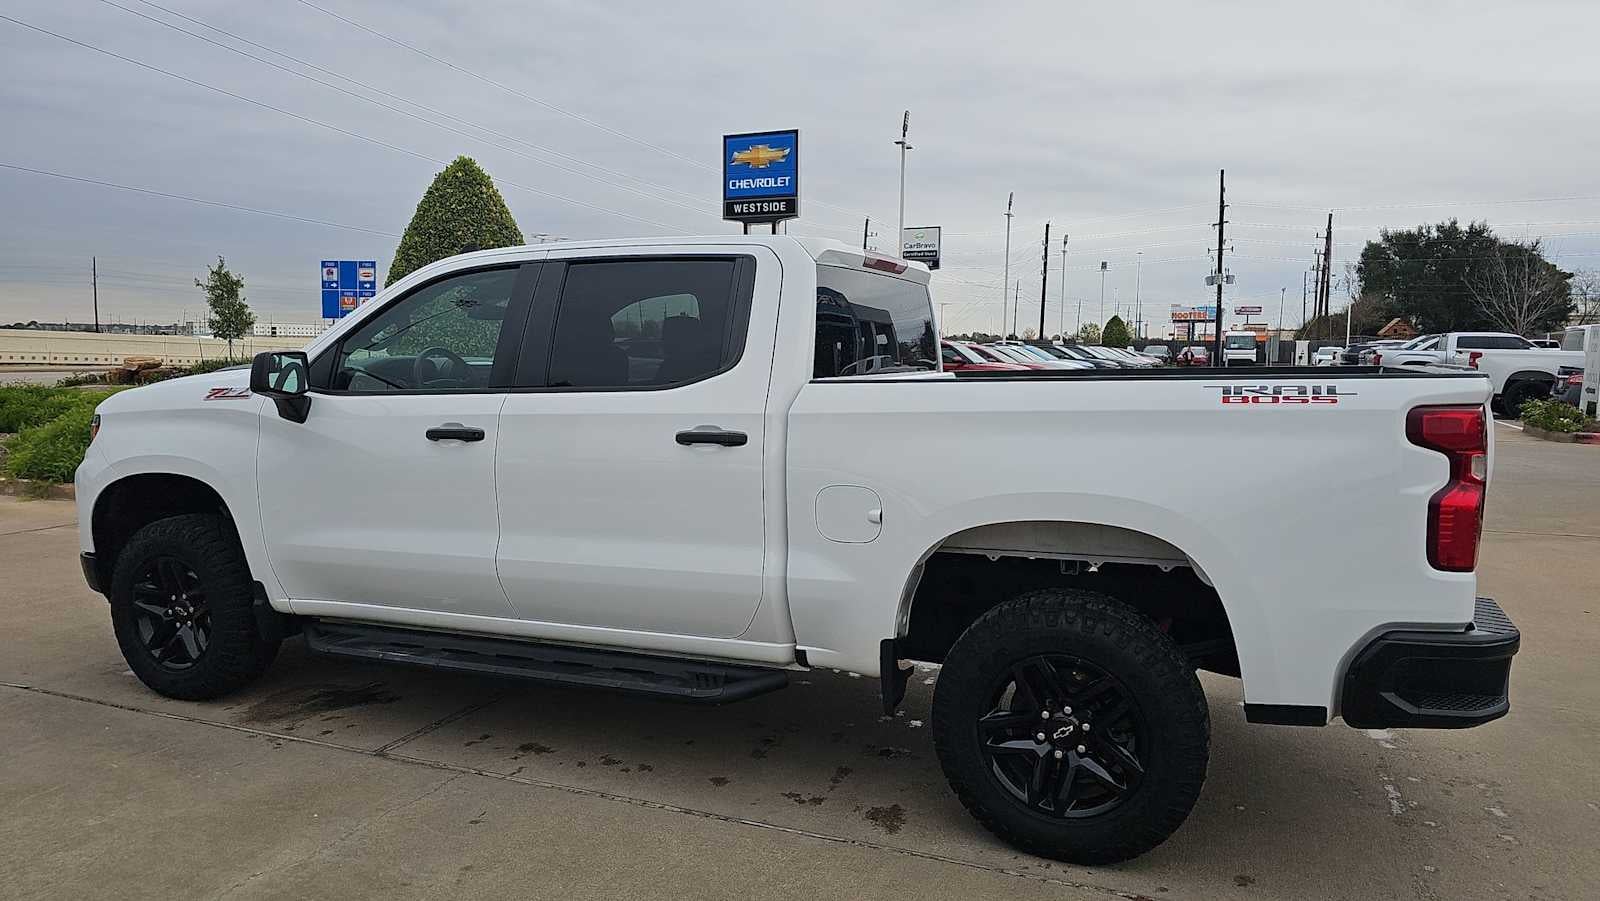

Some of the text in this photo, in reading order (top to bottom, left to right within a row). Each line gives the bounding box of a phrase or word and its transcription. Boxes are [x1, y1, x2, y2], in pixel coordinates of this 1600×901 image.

[729, 176, 791, 190] CHEVROLET
[733, 201, 787, 214] WESTSIDE
[1204, 385, 1357, 395] TRAIL
[1222, 395, 1338, 404] BOSS
